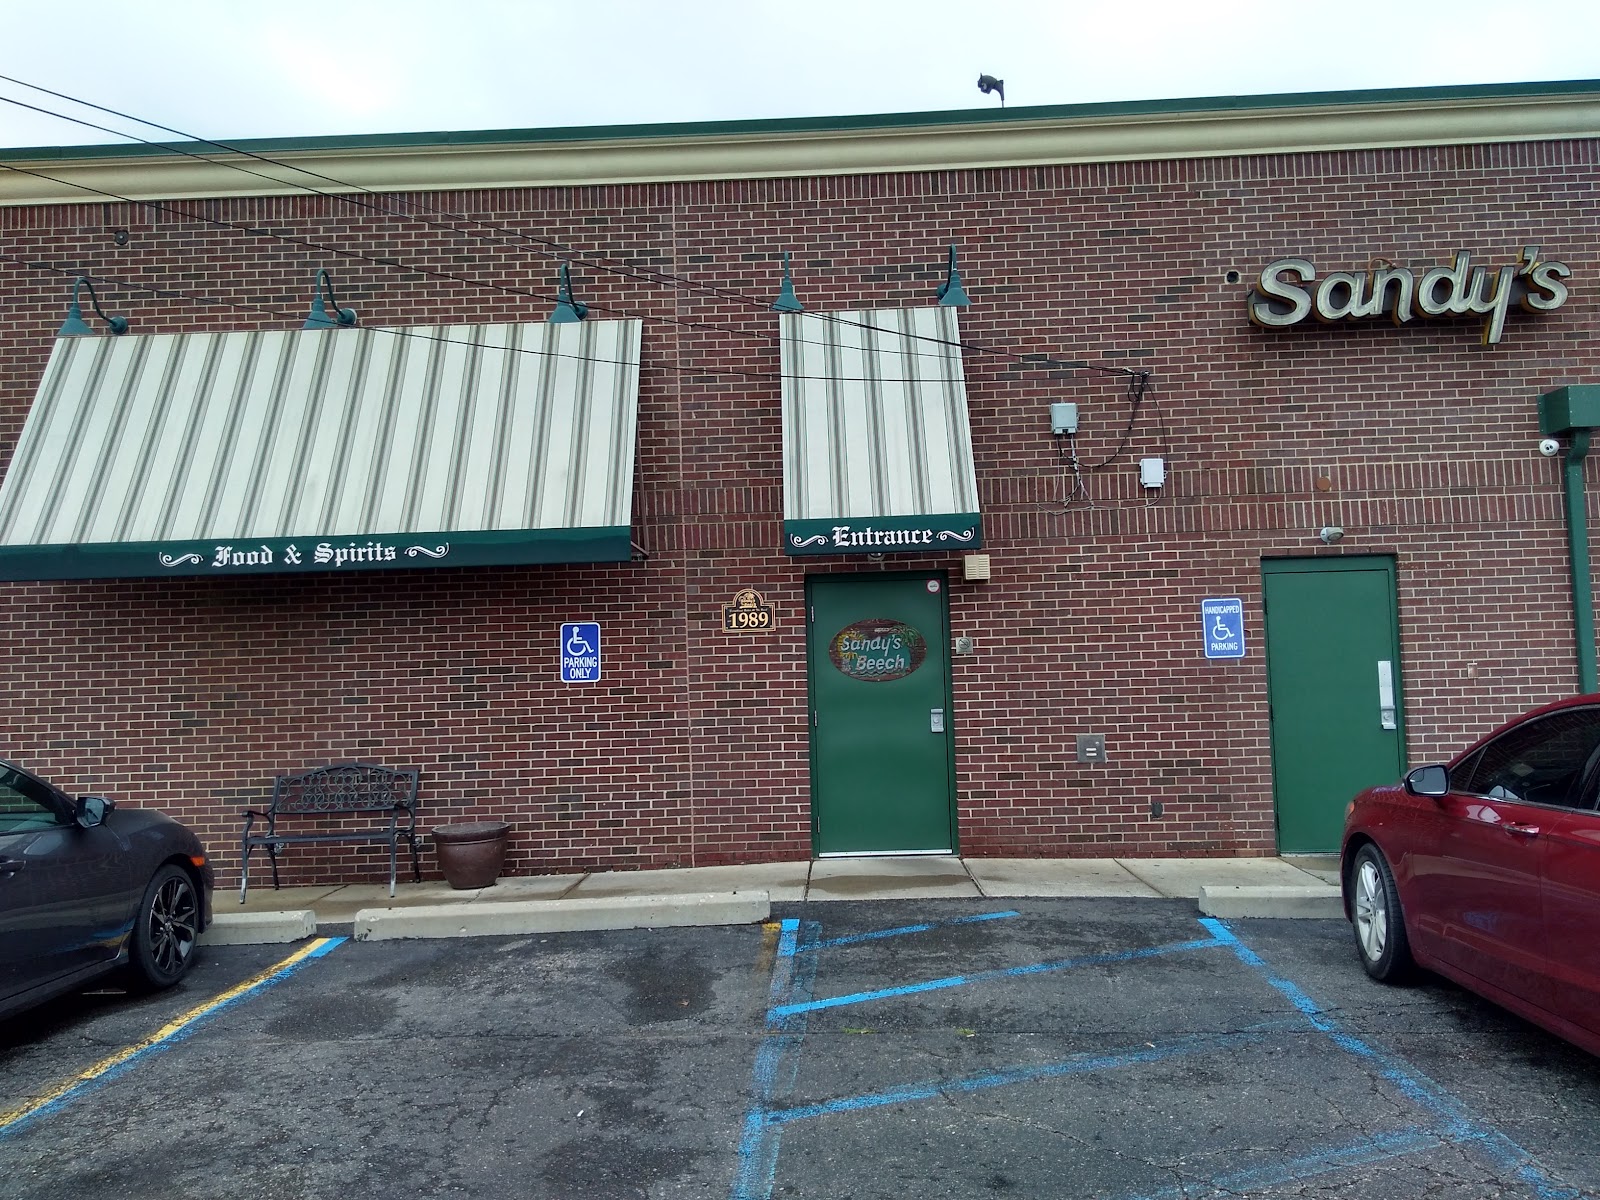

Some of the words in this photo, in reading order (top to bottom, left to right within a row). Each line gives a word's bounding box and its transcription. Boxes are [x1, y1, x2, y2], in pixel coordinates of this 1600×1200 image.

[1251, 246, 1571, 345] Sandy's
[832, 526, 933, 547] Entrance
[212, 545, 273, 567] Food
[284, 544, 302, 565] &
[314, 542, 397, 567] Spirits
[1205, 605, 1240, 614] HANDICAPPED
[728, 611, 769, 628] 1989
[840, 633, 902, 656] Sandy's
[1211, 642, 1238, 651] PARKING
[563, 656, 598, 668] PARKING
[855, 655, 905, 670] Beech
[570, 667, 592, 679] ONLY
